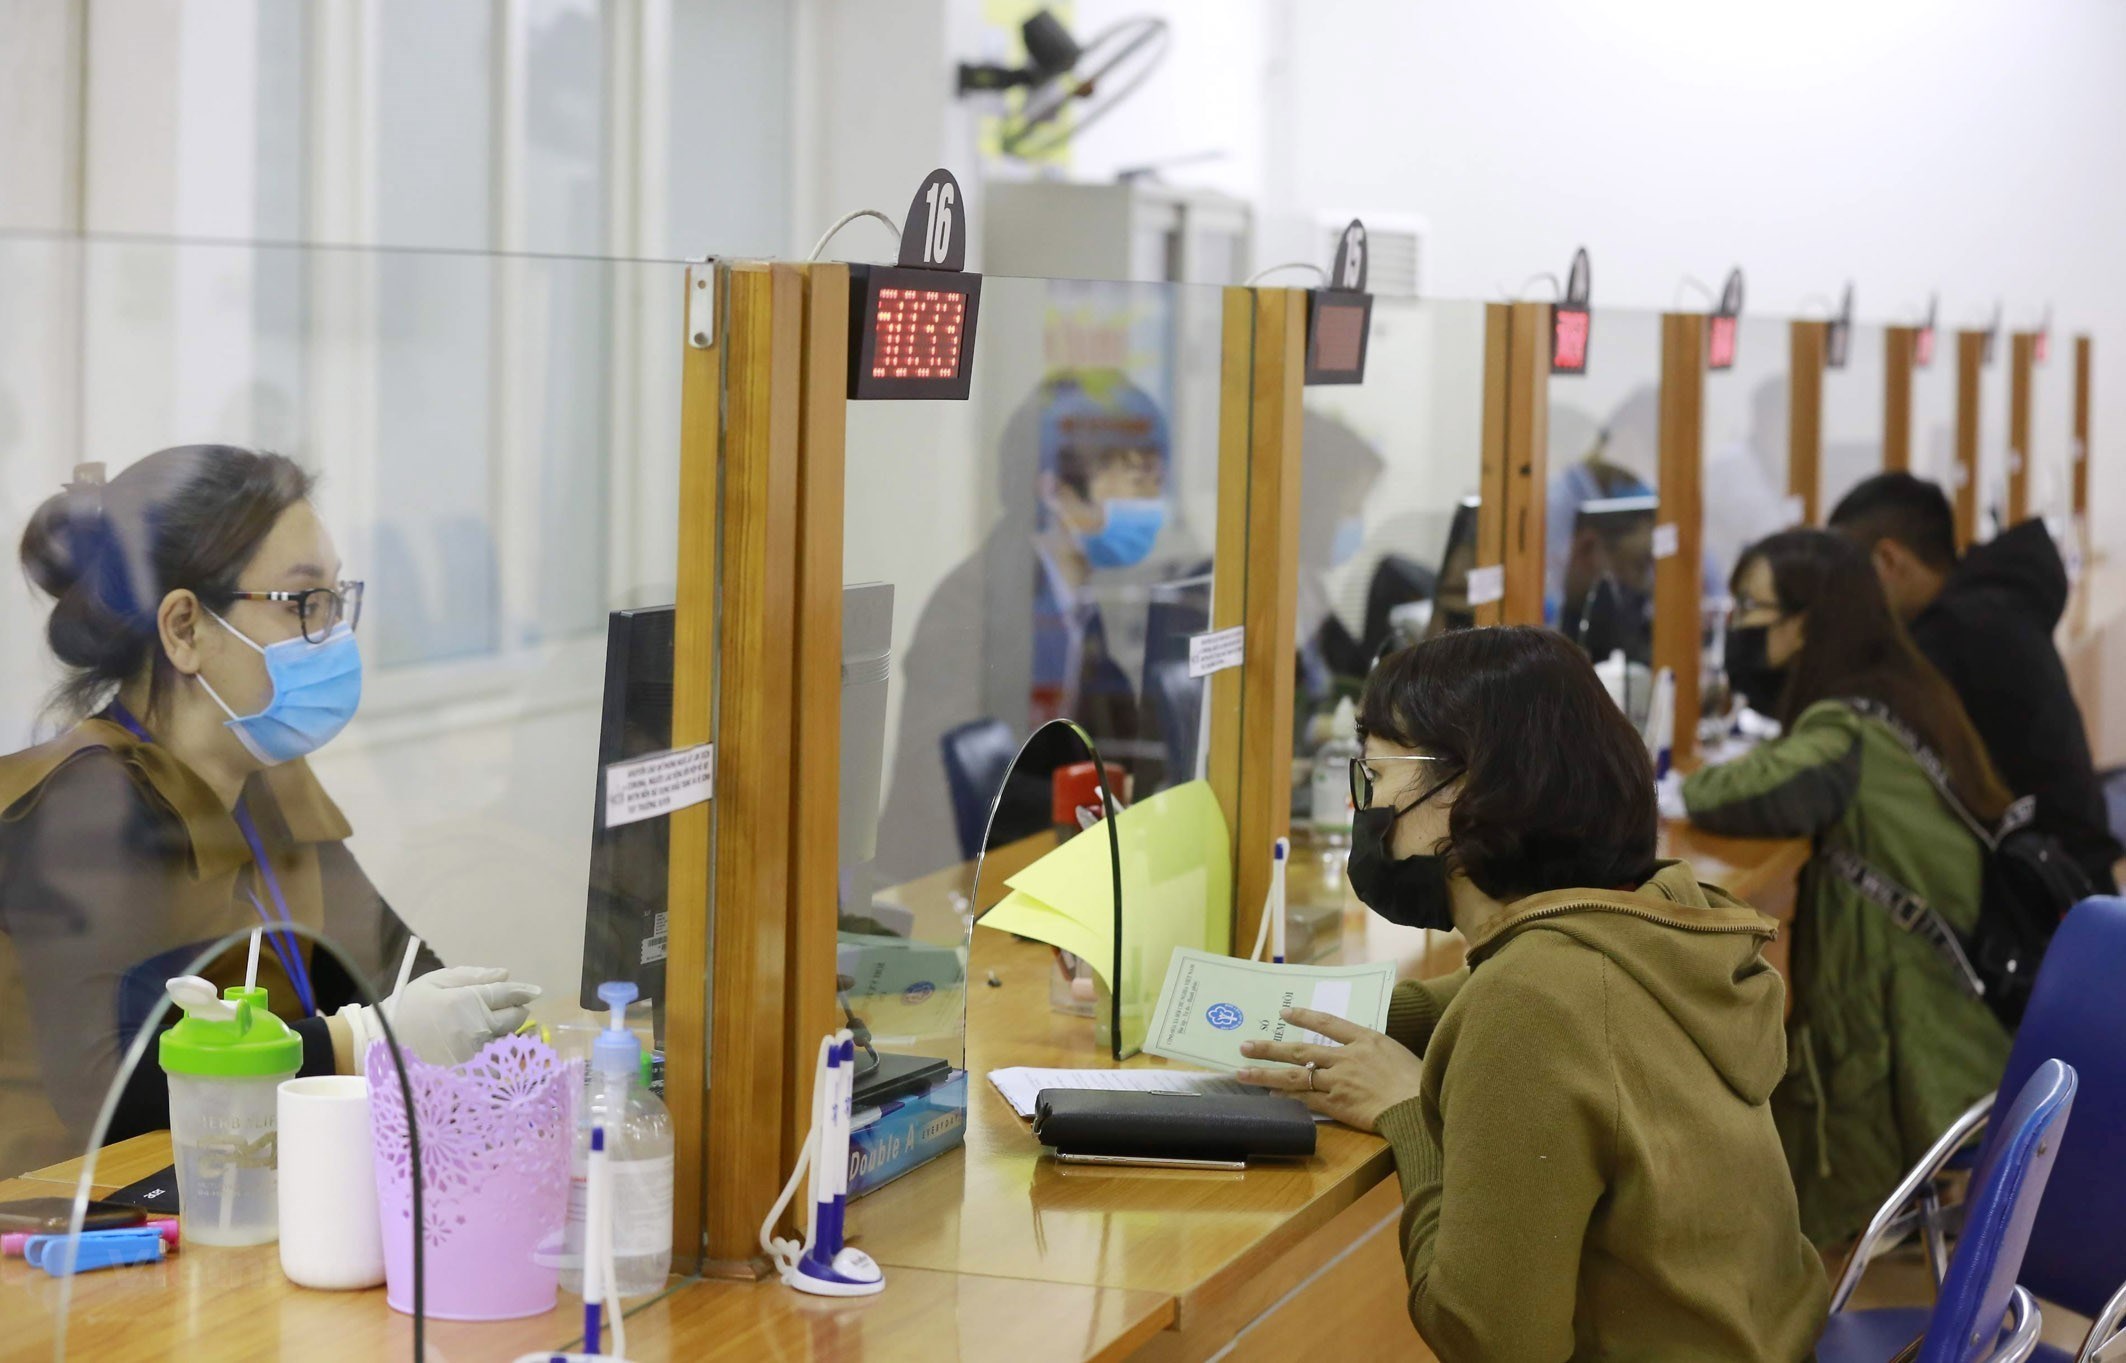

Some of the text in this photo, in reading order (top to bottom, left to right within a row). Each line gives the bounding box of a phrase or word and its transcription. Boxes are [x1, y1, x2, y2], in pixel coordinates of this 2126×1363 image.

[923, 182, 955, 264] 16
[1343, 226, 1364, 289] 15
[848, 1133, 900, 1183] Double
[904, 1122, 916, 1153] A
